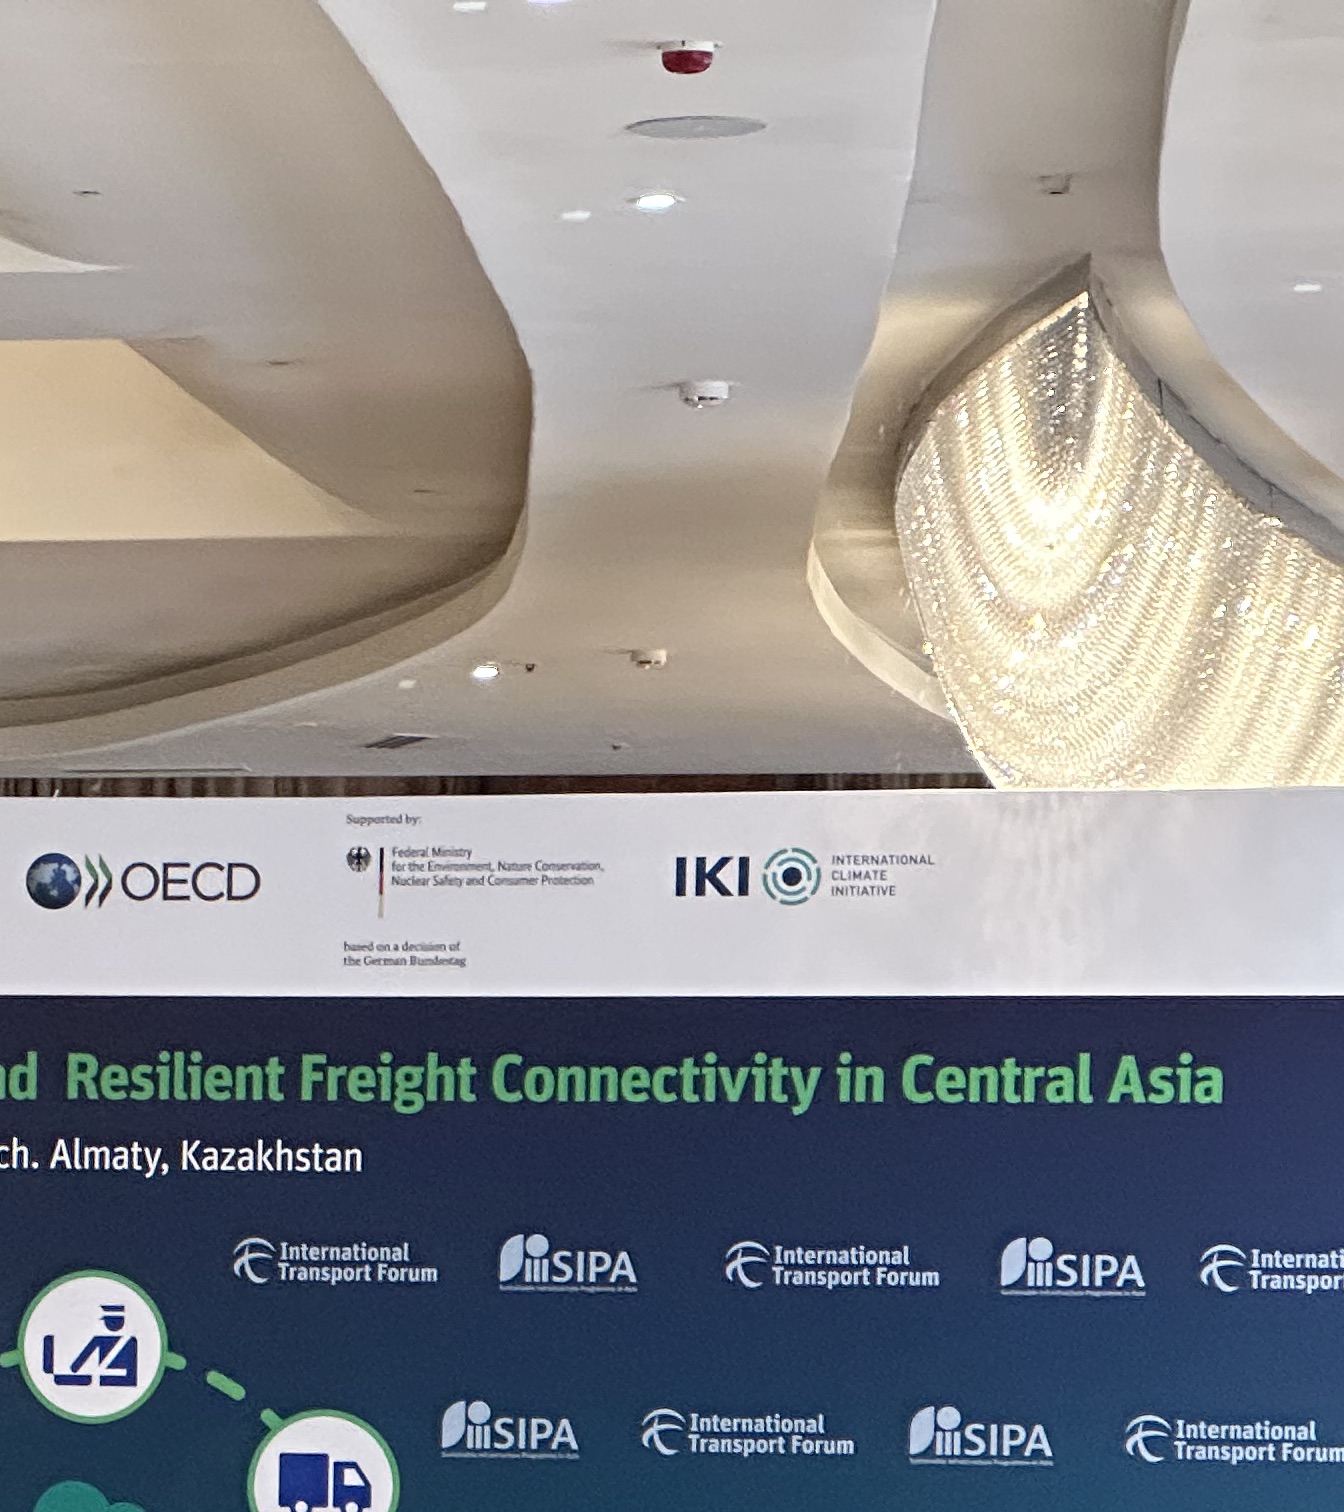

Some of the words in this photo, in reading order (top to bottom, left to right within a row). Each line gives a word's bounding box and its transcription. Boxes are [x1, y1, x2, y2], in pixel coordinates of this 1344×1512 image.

[346, 814, 402, 826] Supported
[392, 847, 431, 858] Federal
[432, 847, 472, 860] Ministry
[832, 855, 934, 865] INTERNATIONAL
[121, 862, 260, 901] OECD
[676, 857, 749, 896] IKI
[832, 870, 887, 881] CLIMATE
[832, 886, 895, 896] INITIATIVE
[67, 1051, 285, 1101] Resilient
[301, 1052, 477, 1114] Freight
[492, 1052, 821, 1115] Connectivity
[836, 1052, 884, 1102] in
[902, 1053, 1093, 1103] Central
[1107, 1052, 1223, 1103] Asia
[50, 1138, 169, 1178] Almaty,
[182, 1139, 362, 1172] Kazakhstan
[278, 1242, 409, 1262] International
[772, 1245, 910, 1265] International
[278, 1263, 374, 1285] Transport
[376, 1263, 437, 1282] Forum
[552, 1251, 636, 1283] SIPA
[772, 1267, 870, 1289] Transport
[877, 1267, 939, 1286] Forum
[1055, 1254, 1145, 1288] SIPA
[1249, 1270, 1344, 1294] Transpor
[493, 1418, 578, 1450] SIPA
[688, 1413, 824, 1433] International
[1174, 1420, 1316, 1441] International
[688, 1434, 785, 1457] Transport
[792, 1434, 854, 1454] Forum
[960, 1423, 1052, 1457] SIPA
[1174, 1441, 1276, 1465] Transport
[1282, 1442, 1344, 1462] Forum
